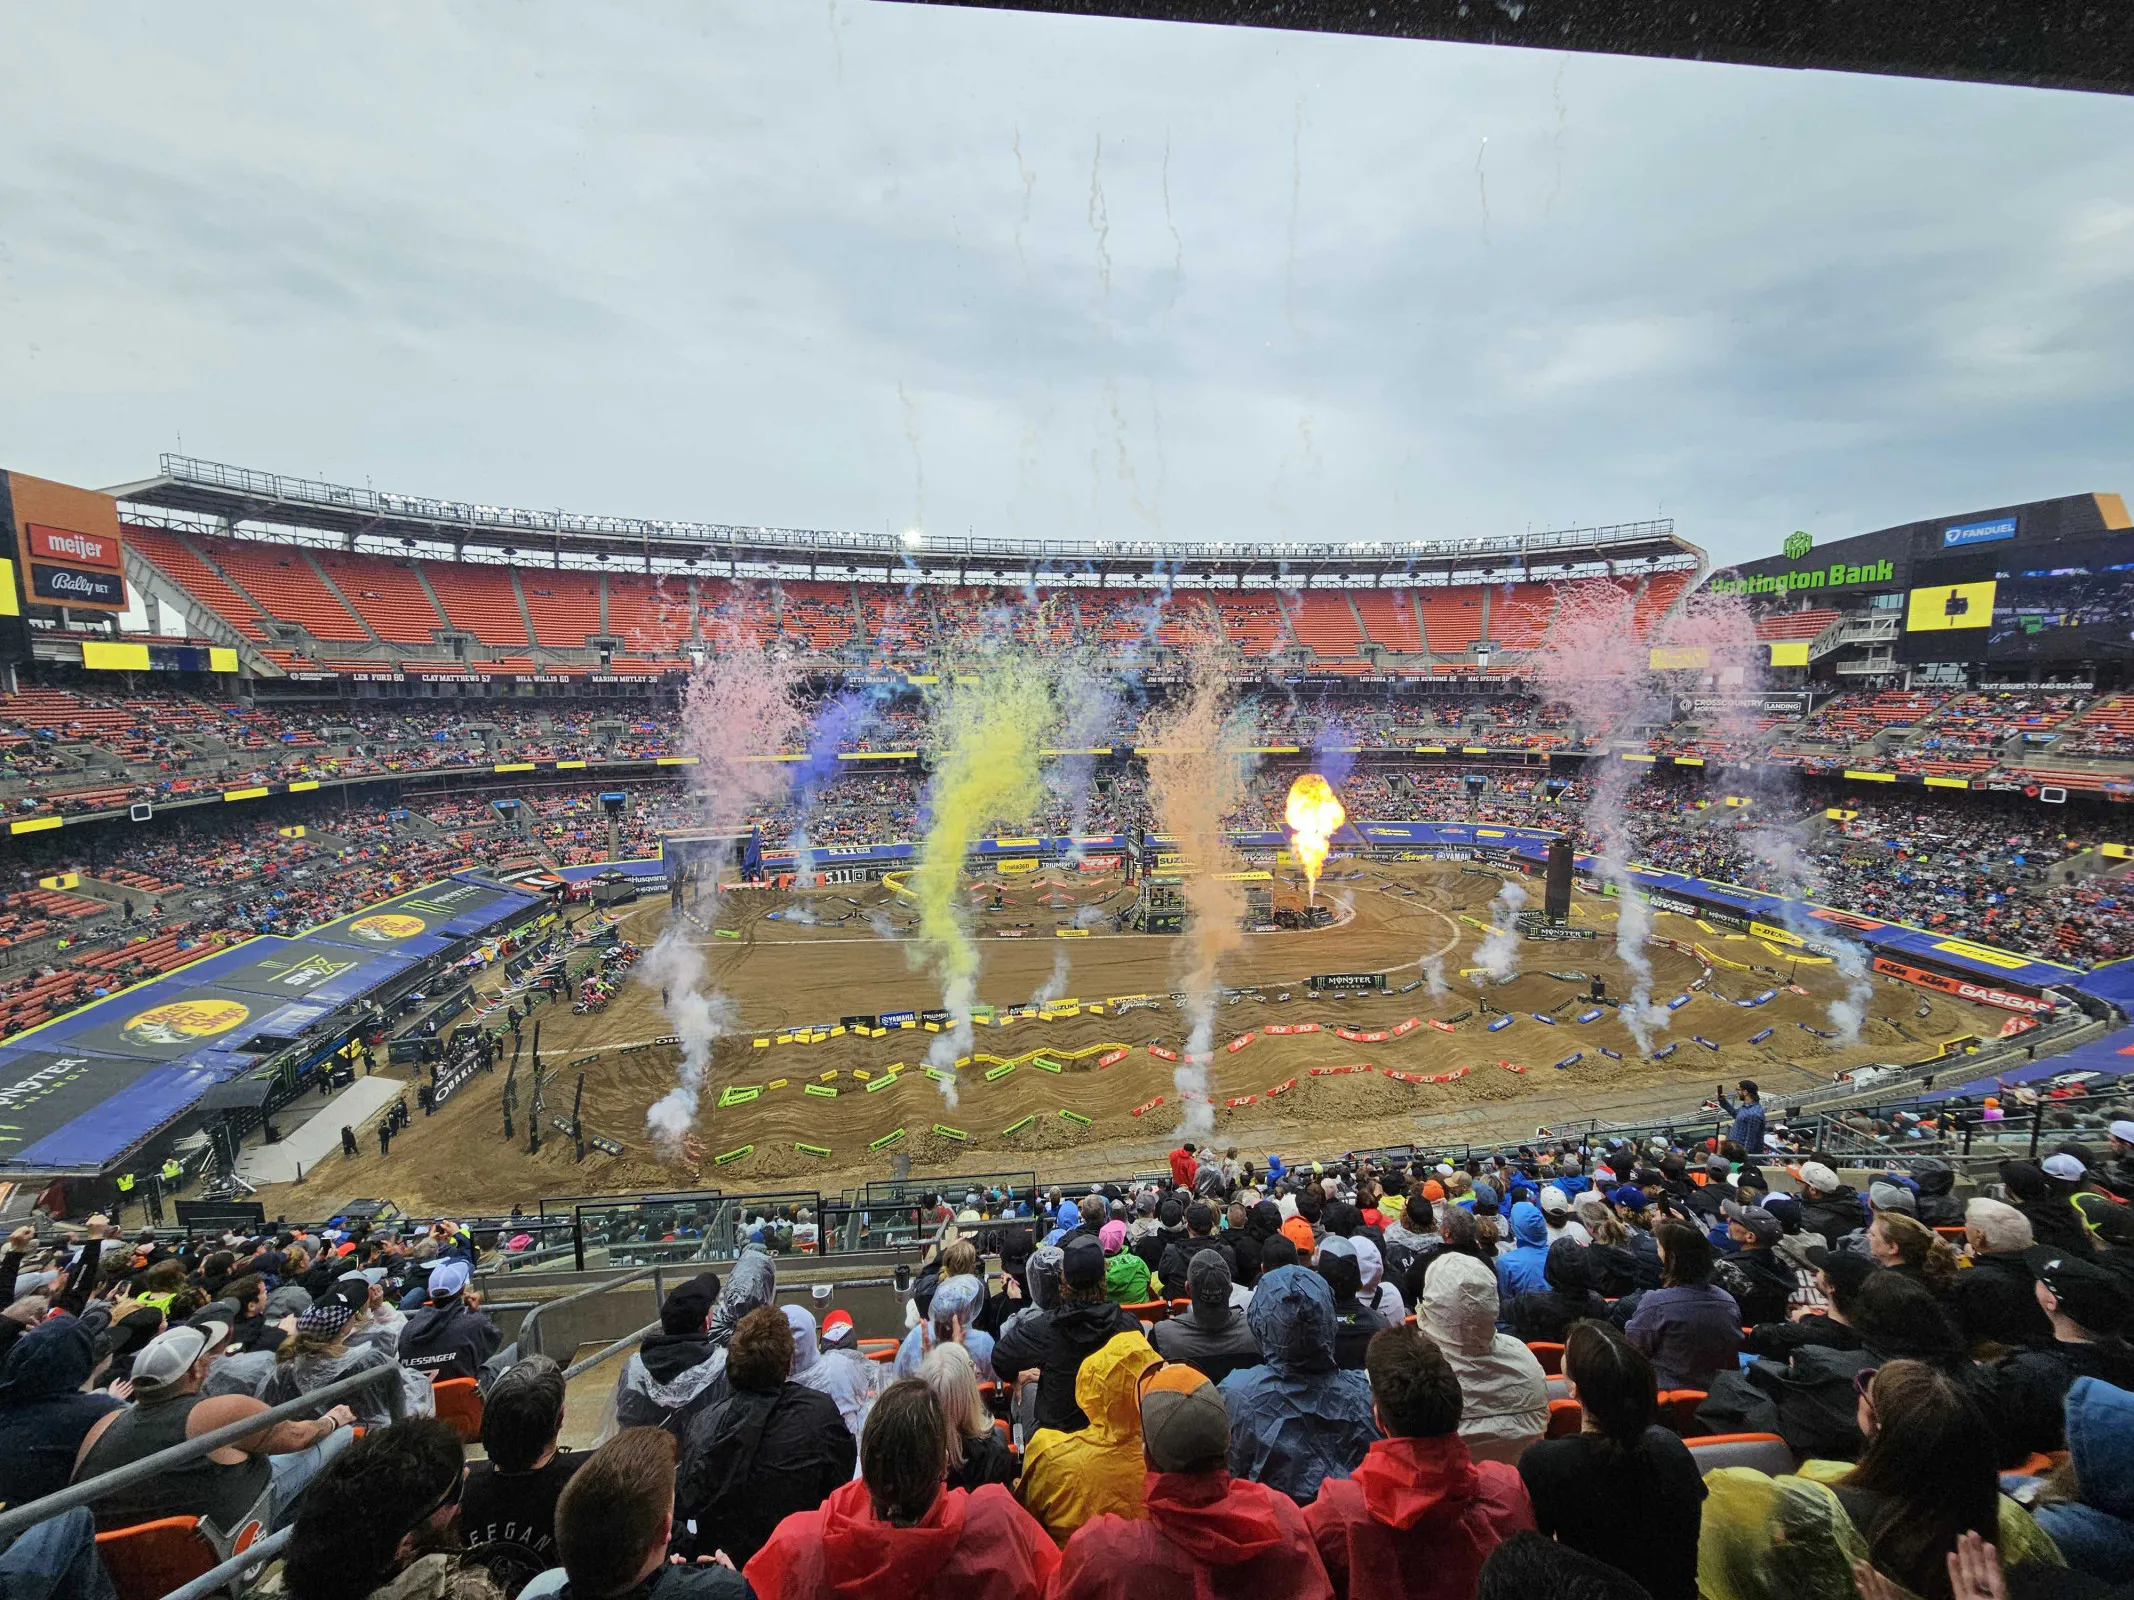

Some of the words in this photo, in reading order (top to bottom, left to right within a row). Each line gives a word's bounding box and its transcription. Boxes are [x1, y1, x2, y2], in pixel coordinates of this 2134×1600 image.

[1962, 523, 2016, 539] FANDUEL
[48, 534, 102, 559] meijer
[1828, 559, 1894, 586] Bank
[51, 572, 93, 596] Bally
[95, 583, 108, 594] BET
[353, 673, 368, 681] LEN
[371, 673, 392, 681] FORD
[422, 674, 438, 682] CLAY
[439, 674, 480, 682] MATTHEWS
[481, 674, 491, 683] 57
[631, 875, 668, 884] Husqvarna
[825, 869, 852, 885] 5.11
[1708, 911, 1740, 924] MONSTER
[1541, 928, 1581, 938] MONSTER
[1878, 962, 1908, 977] KTM
[1328, 976, 1371, 985] MONSTER
[1918, 973, 1950, 990] KTM
[1958, 985, 2051, 1013] GASGAS
[888, 1013, 914, 1023] YAMAHA
[922, 1012, 949, 1020] TRIUMPH
[1272, 1025, 1287, 1033] FLY
[1299, 1024, 1314, 1032] FLY
[1400, 1021, 1414, 1032] FLY
[1343, 1031, 1356, 1039] FLY
[1367, 1033, 1381, 1041] FLY
[1234, 1035, 1248, 1049] FLY
[1106, 1051, 1122, 1063] FLY
[1155, 1048, 1170, 1058] FLY
[988, 1063, 1014, 1079] Kawasaki
[1035, 1059, 1060, 1071] Kawasaki
[1320, 1066, 1335, 1075] FLY
[1350, 1064, 1365, 1072] FLY
[1392, 1071, 1406, 1080] FLY
[1448, 1070, 1463, 1080] FLY
[0, 1058, 88, 1106] ONSTER
[868, 1074, 895, 1090] Kawasaki
[10, 1067, 89, 1110] ENERGY
[809, 1087, 835, 1098] Kawasaki
[1275, 1082, 1290, 1095] FLY
[728, 1090, 756, 1104] Kawasaki
[1234, 1096, 1250, 1105] FLY
[1141, 1101, 1156, 1113] FLY
[1063, 1110, 1089, 1124] Kawasaki
[937, 1126, 965, 1138] Kawasaki
[1006, 1117, 1033, 1136] Kawasaki
[873, 1132, 901, 1150] Kawasaki
[719, 1148, 749, 1164] Kawasaki
[799, 1146, 829, 1158] Kawasaki
[401, 1351, 457, 1366] PLESSINGER
